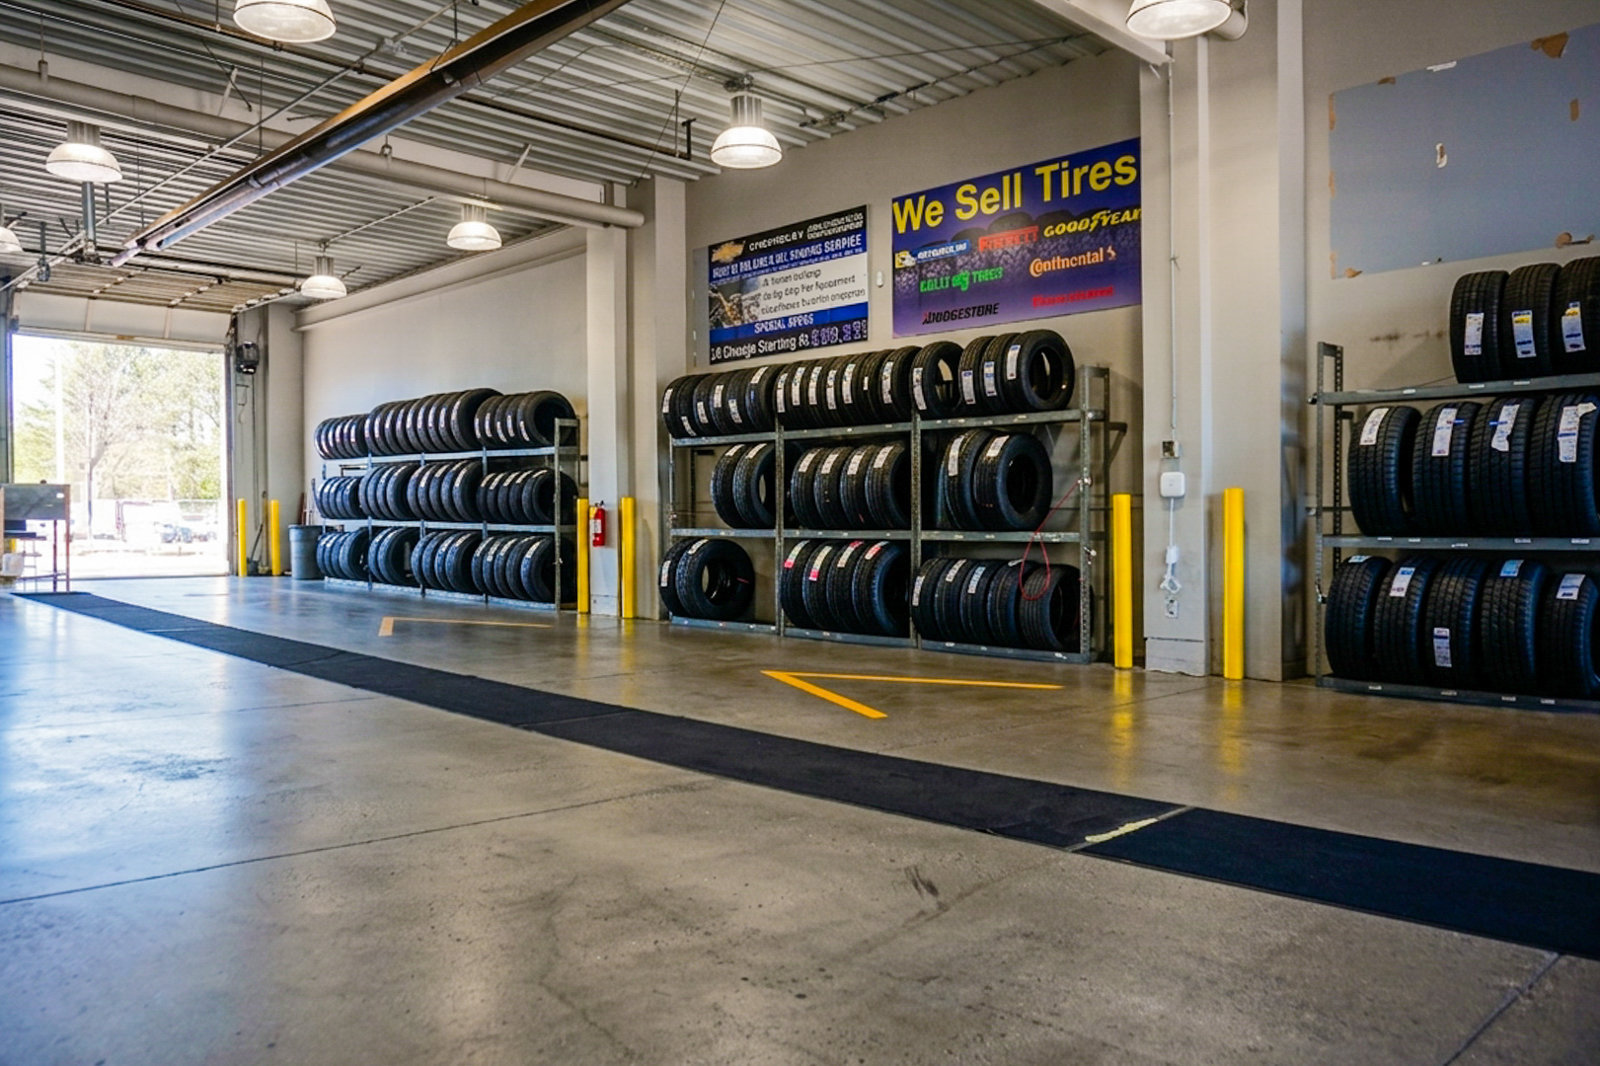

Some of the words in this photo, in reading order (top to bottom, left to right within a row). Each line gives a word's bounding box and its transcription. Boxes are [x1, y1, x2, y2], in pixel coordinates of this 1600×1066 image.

[893, 195, 945, 234] We
[955, 172, 1022, 220] Sell
[1035, 155, 1137, 202] Tires
